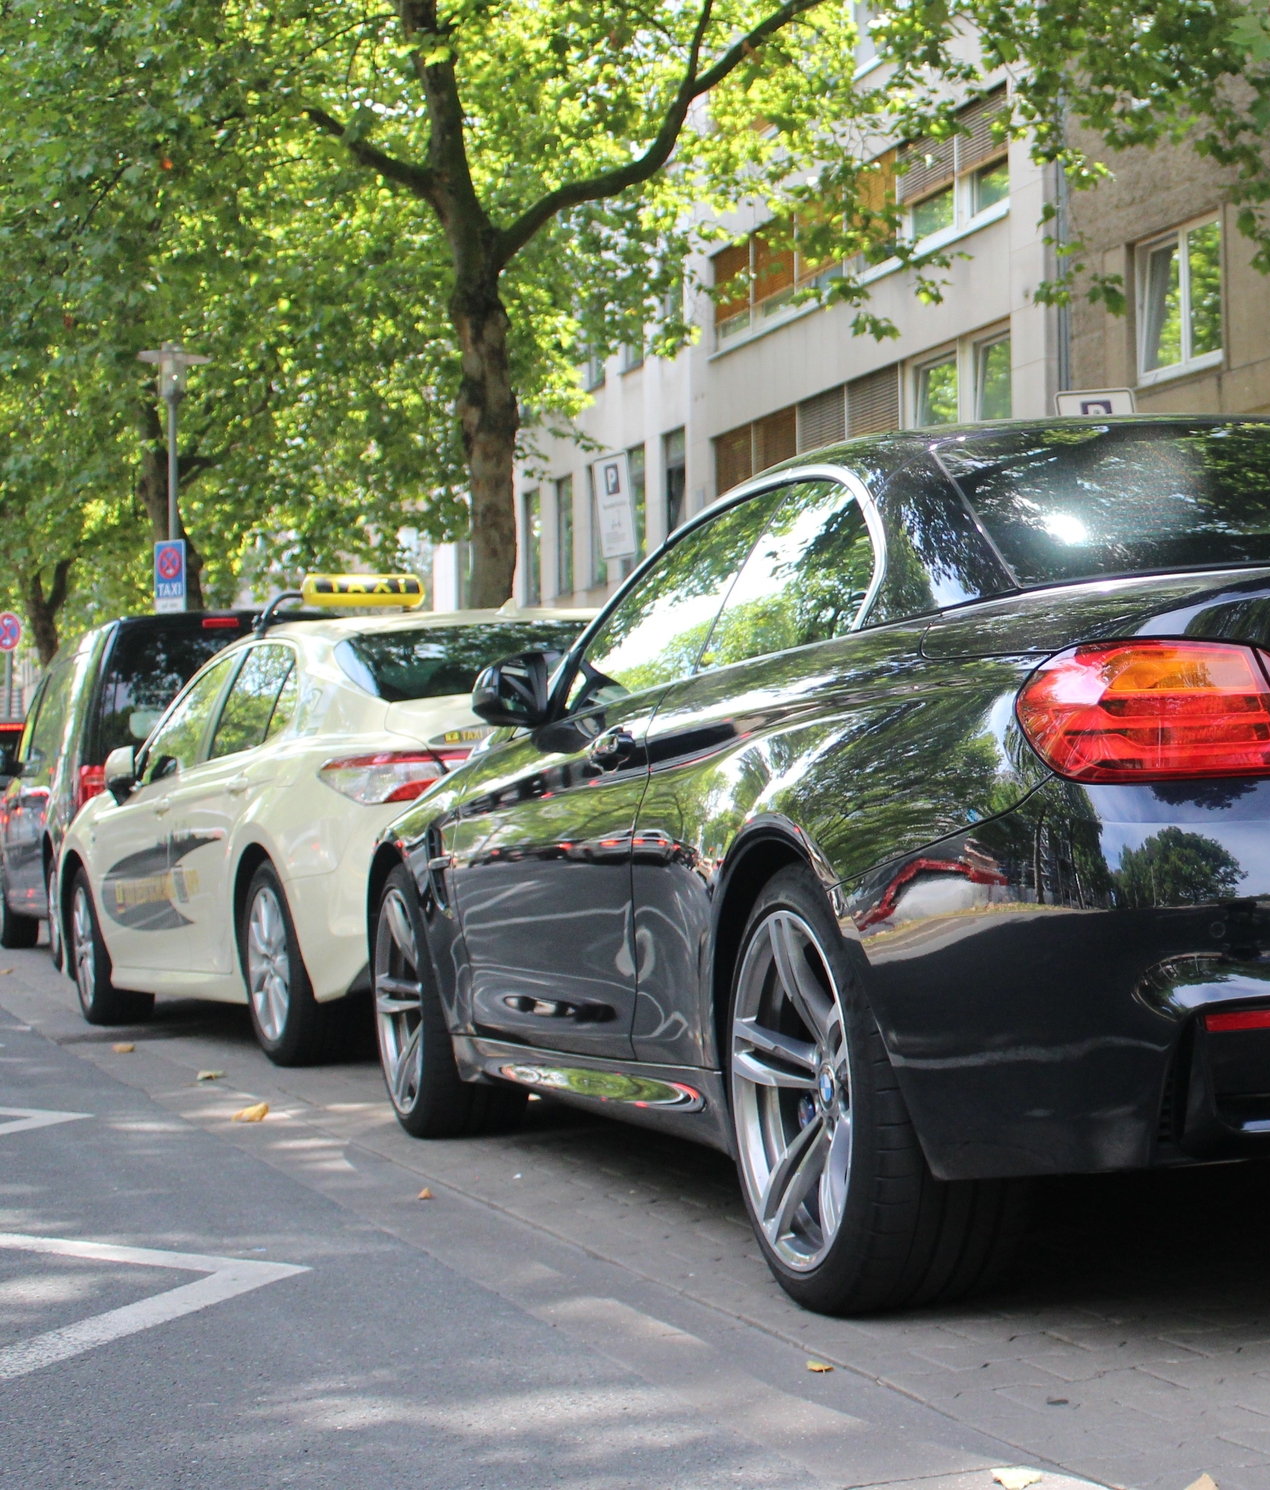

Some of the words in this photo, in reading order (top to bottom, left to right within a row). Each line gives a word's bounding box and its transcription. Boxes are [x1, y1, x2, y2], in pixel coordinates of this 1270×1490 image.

[606, 467, 618, 493] P
[157, 582, 183, 597] TAXI
[461, 728, 483, 741] TAXI
